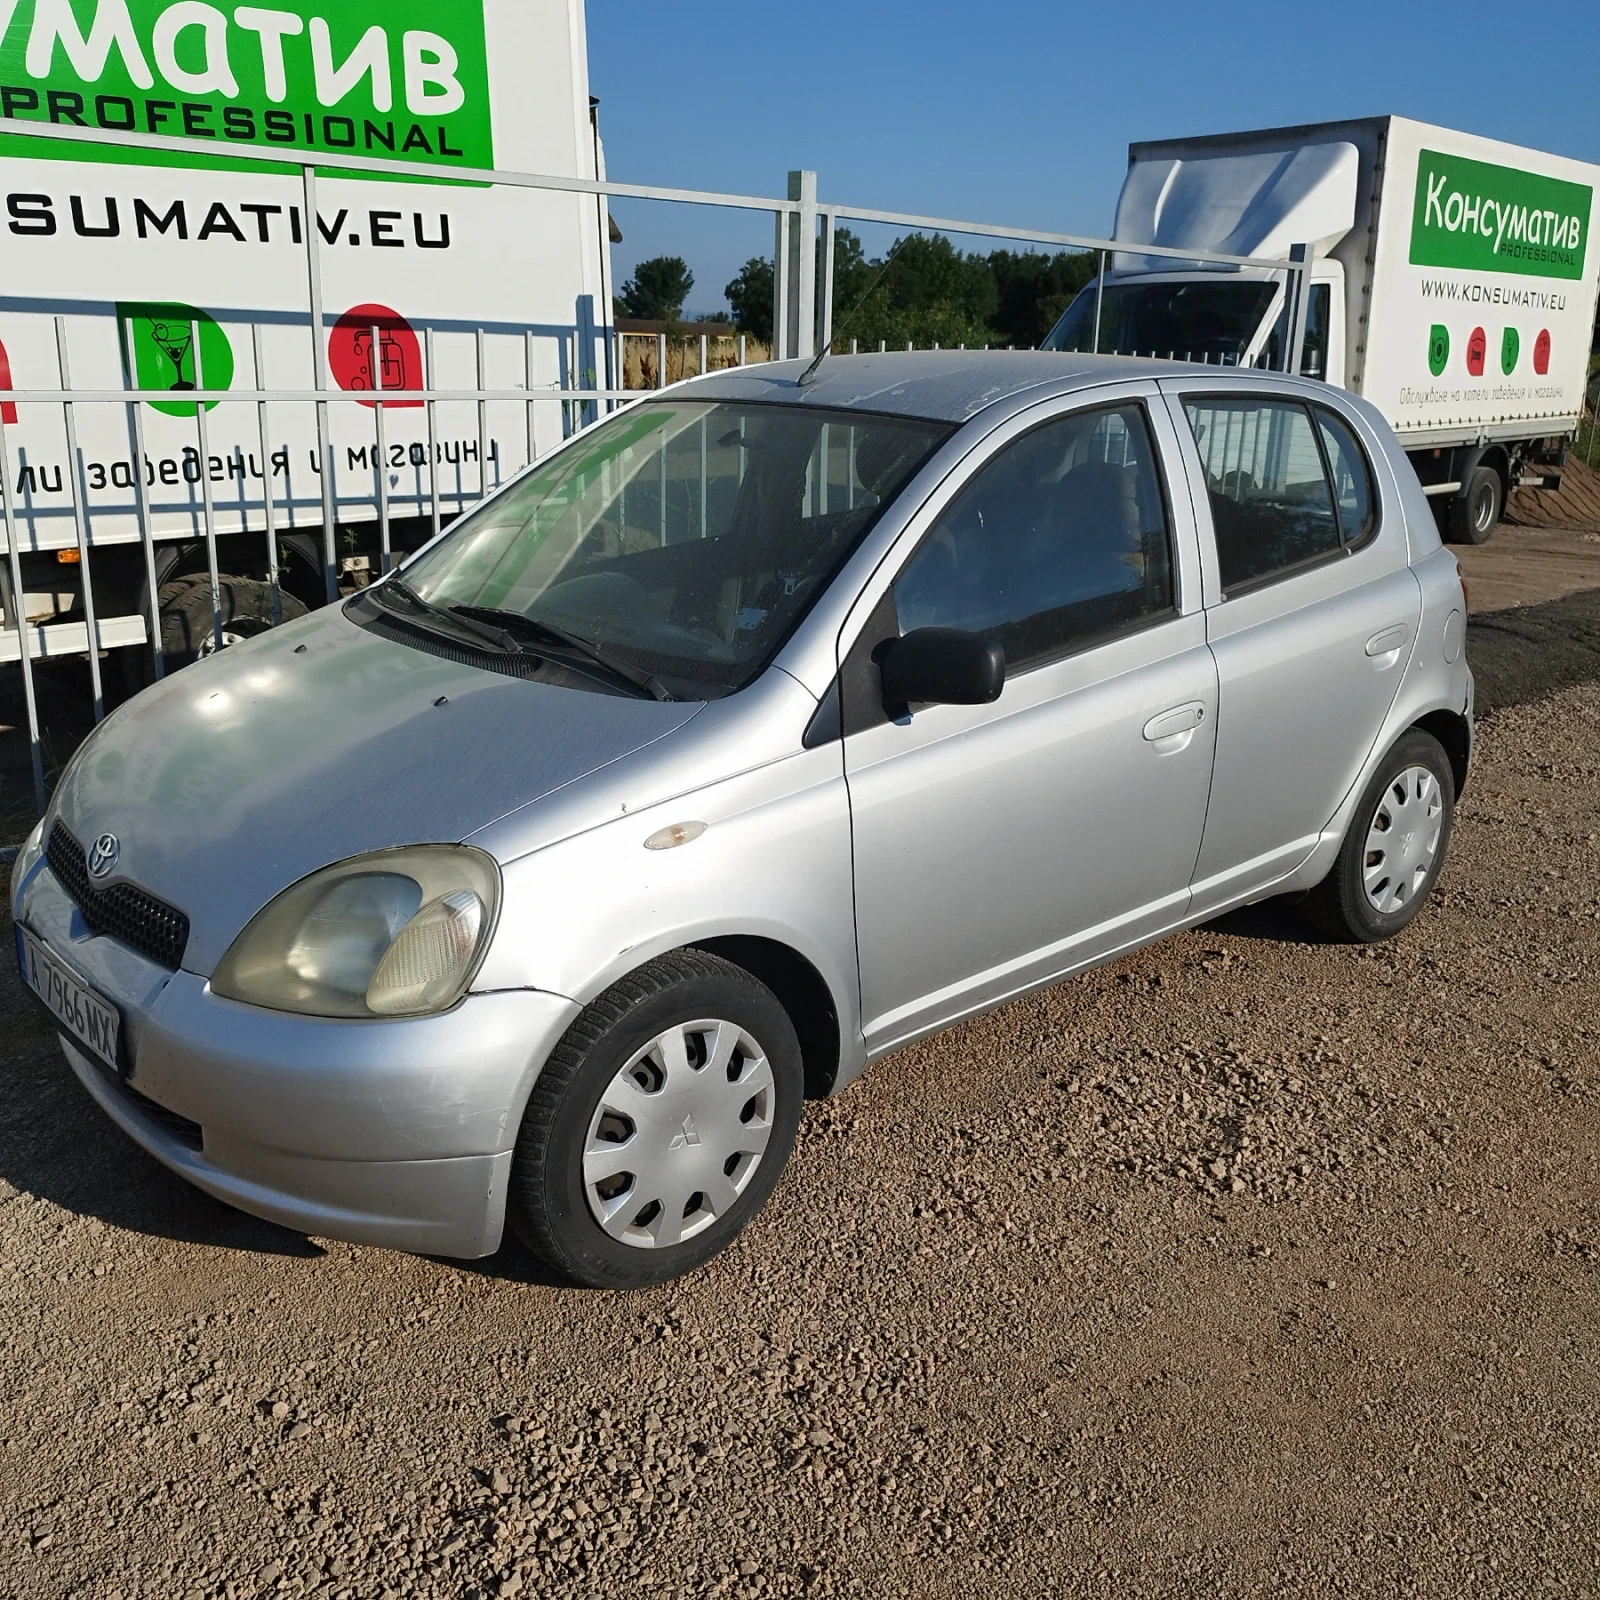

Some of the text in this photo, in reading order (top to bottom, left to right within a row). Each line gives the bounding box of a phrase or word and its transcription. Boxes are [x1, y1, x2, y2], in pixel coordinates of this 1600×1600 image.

[0, 86, 464, 157] PROFESSIONAL
[8, 193, 451, 249] SUMATIV.EU
[1424, 171, 1580, 254] Консуматив
[1501, 243, 1575, 265] PROFESSIONAL
[1421, 279, 1566, 310] WWW.KONSUMATIV.EU
[1451, 389, 1460, 402] на
[1463, 388, 1489, 401] хотели
[1527, 387, 1533, 399] и
[0, 464, 63, 494] ли
